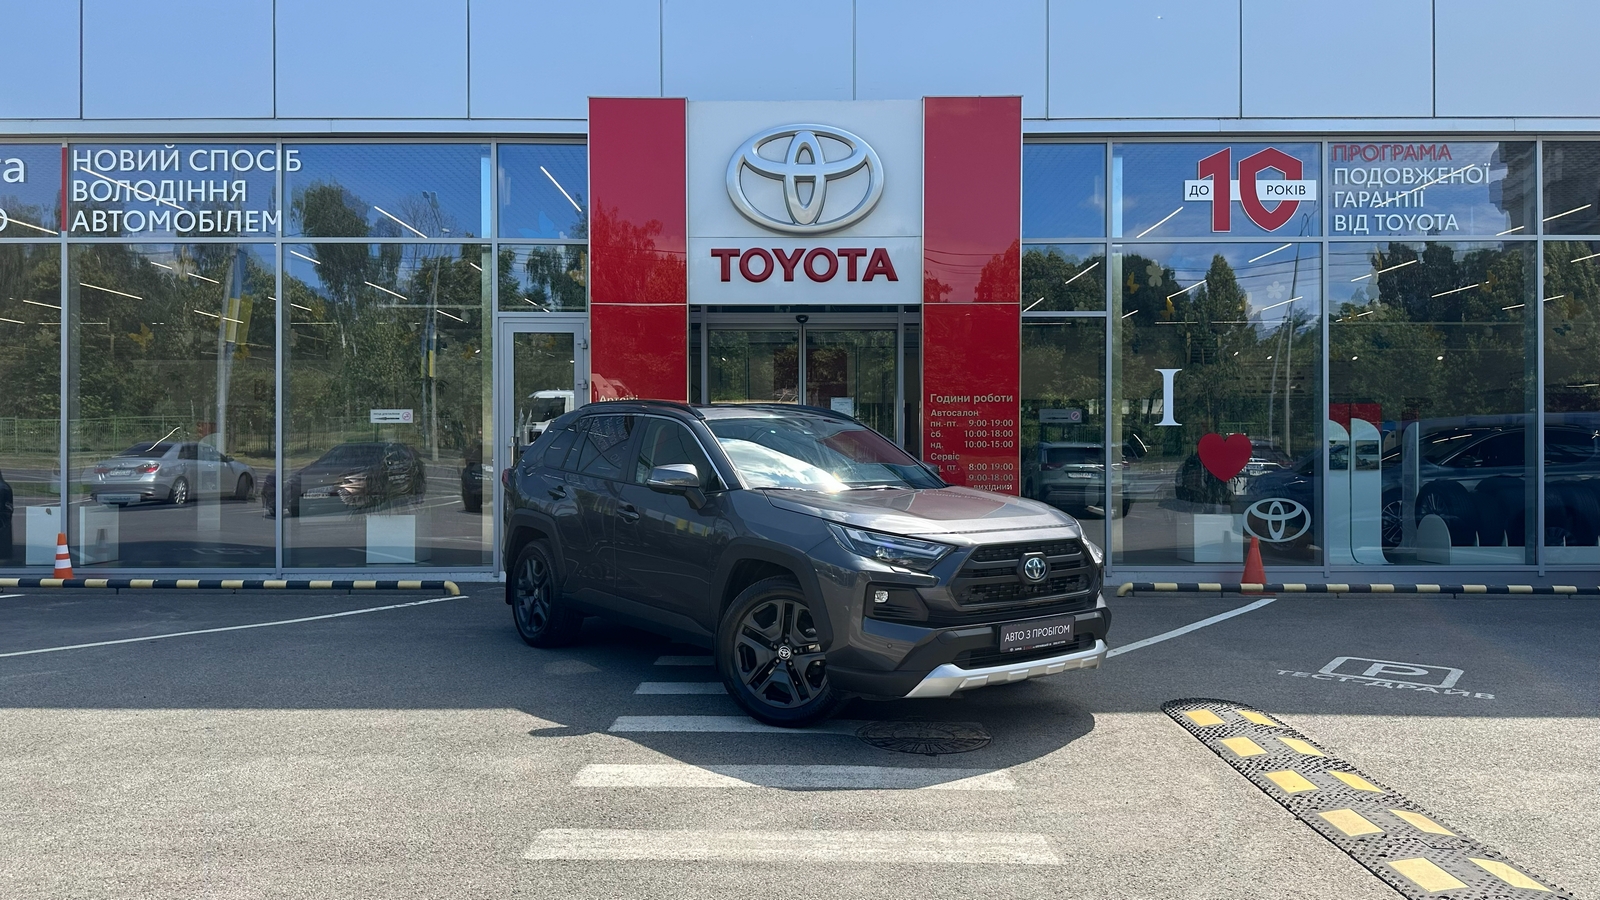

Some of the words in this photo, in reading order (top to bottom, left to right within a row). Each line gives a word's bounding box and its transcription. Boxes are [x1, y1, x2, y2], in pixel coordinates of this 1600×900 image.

[72, 144, 179, 171] НОВИЙ
[189, 149, 302, 172] СПОСІБ
[1332, 144, 1452, 161] ПРОГРАМА
[1334, 163, 1491, 188] ПОДОВЖЕНОЇ
[72, 179, 247, 206] ВОЛОДІННЯ
[1189, 185, 1209, 197] ДО
[1198, 146, 1303, 232] 10
[1266, 185, 1306, 195] РОКІВ
[1334, 187, 1426, 208] ГАРАНТІЇ
[71, 210, 282, 232] АВТОМОБІЛЕМ
[1335, 214, 1369, 235] ВІД
[1374, 213, 1459, 231] TOYOTA
[710, 247, 899, 283] TOYOTA
[930, 394, 970, 404] Години
[973, 393, 1013, 404] роботи
[1154, 368, 1182, 426] I
[930, 409, 979, 417] Автосалон
[930, 430, 944, 438] сб.
[964, 430, 1014, 438] 10:00-18:00
[930, 451, 960, 461] Сервіс
[968, 474, 1014, 482] 9:00-18:00
[973, 483, 1013, 492] вихідний
[1004, 631, 1025, 642] АВТО
[1032, 625, 1070, 638] ПРОБІГОМ
[1276, 669, 1496, 700] ТЕСТ-ДРАЙВ
